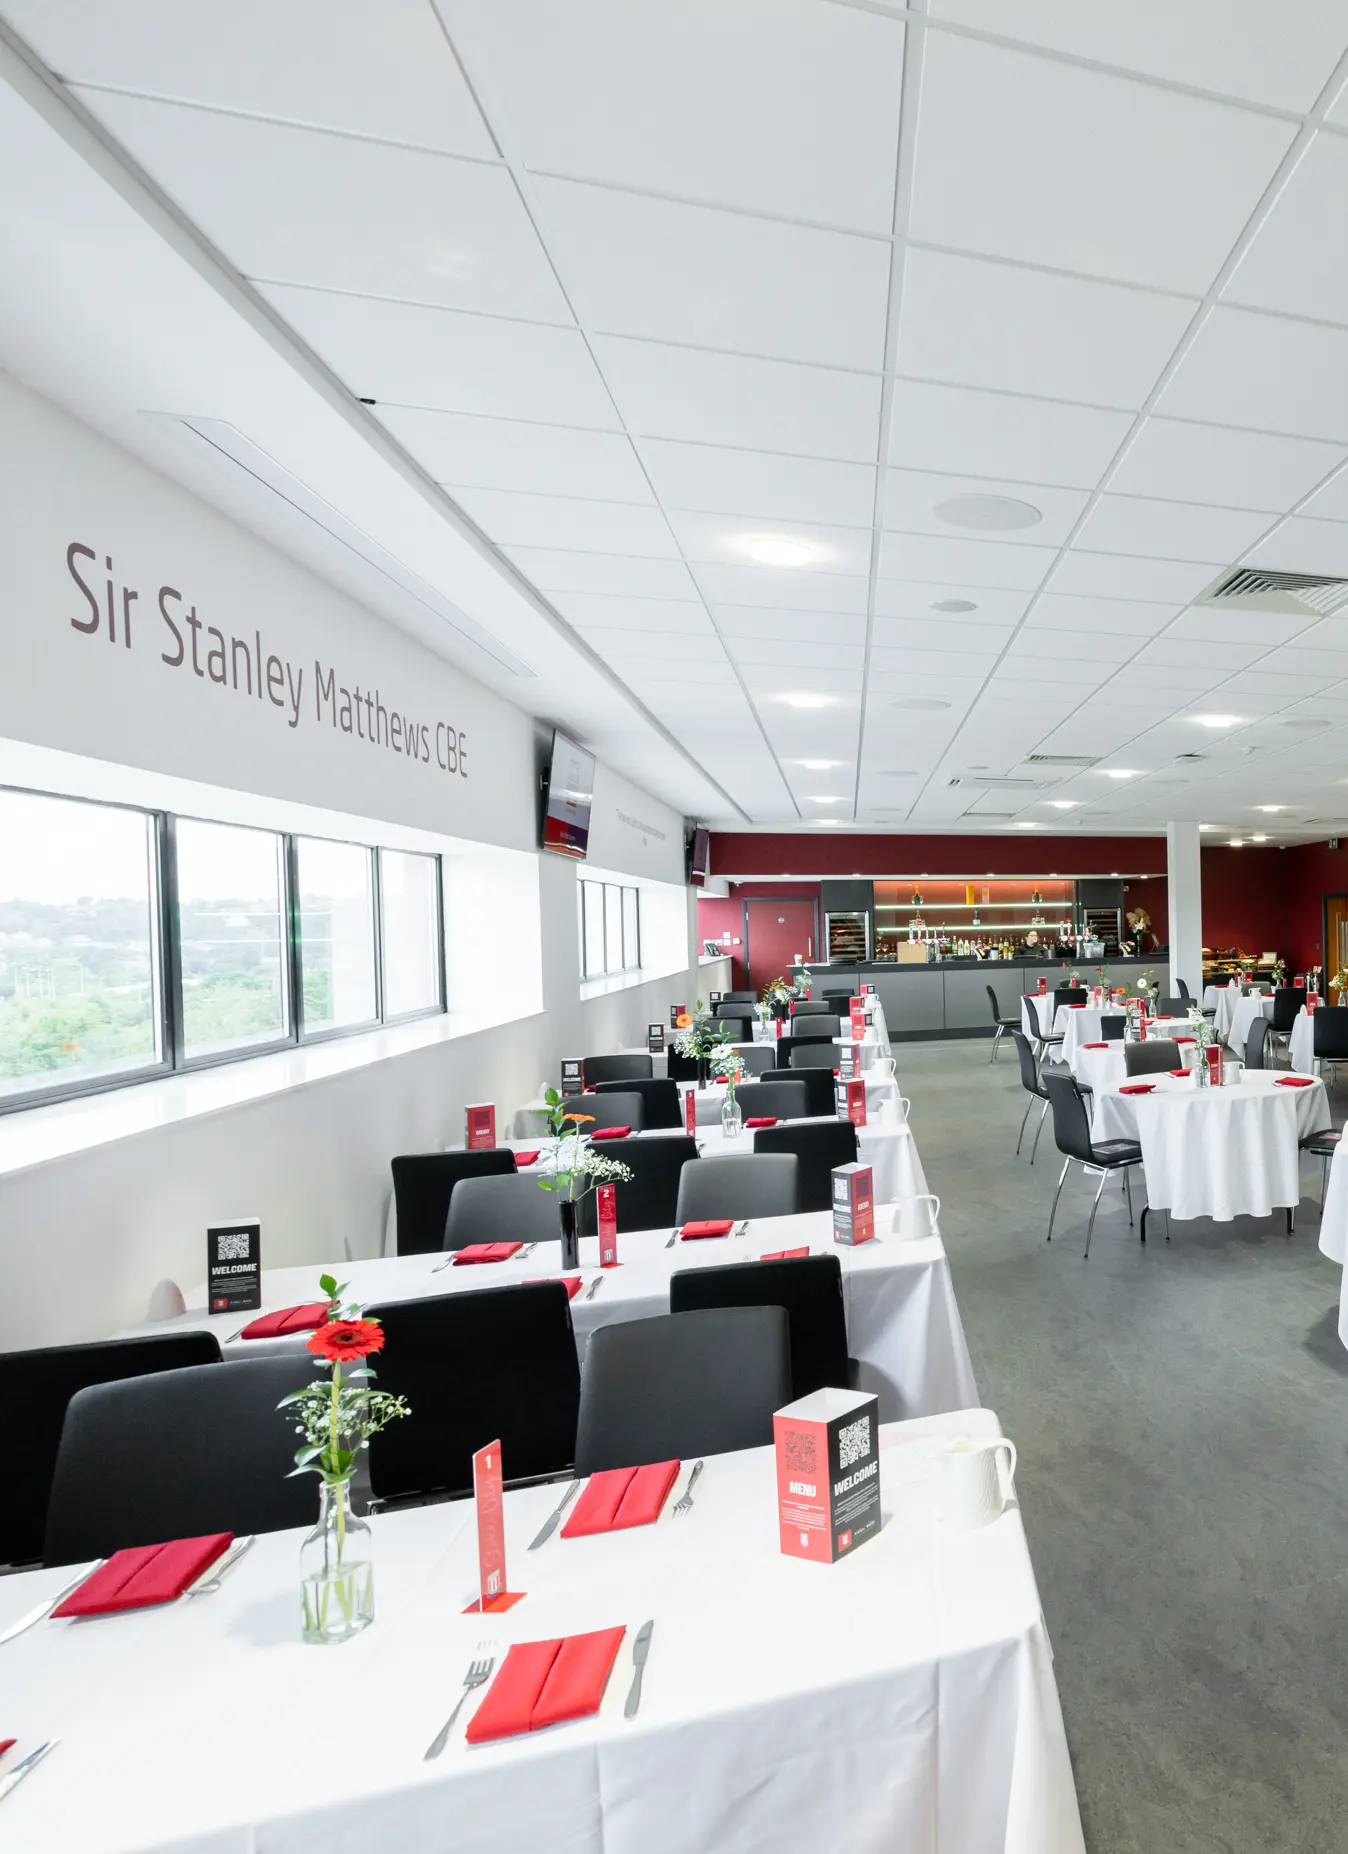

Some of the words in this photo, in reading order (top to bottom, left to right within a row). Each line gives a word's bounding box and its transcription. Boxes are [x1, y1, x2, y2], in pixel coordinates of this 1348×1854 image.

[67, 542, 138, 649] Sir
[158, 586, 303, 728] Stanley
[315, 660, 430, 763] Matthews
[436, 721, 468, 778] CBE
[603, 1189, 610, 1198] 2
[211, 1262, 258, 1276] WELCOME
[484, 1454, 492, 1469] 1
[833, 1460, 878, 1497] WELCOME
[789, 1480, 817, 1498] MENU
